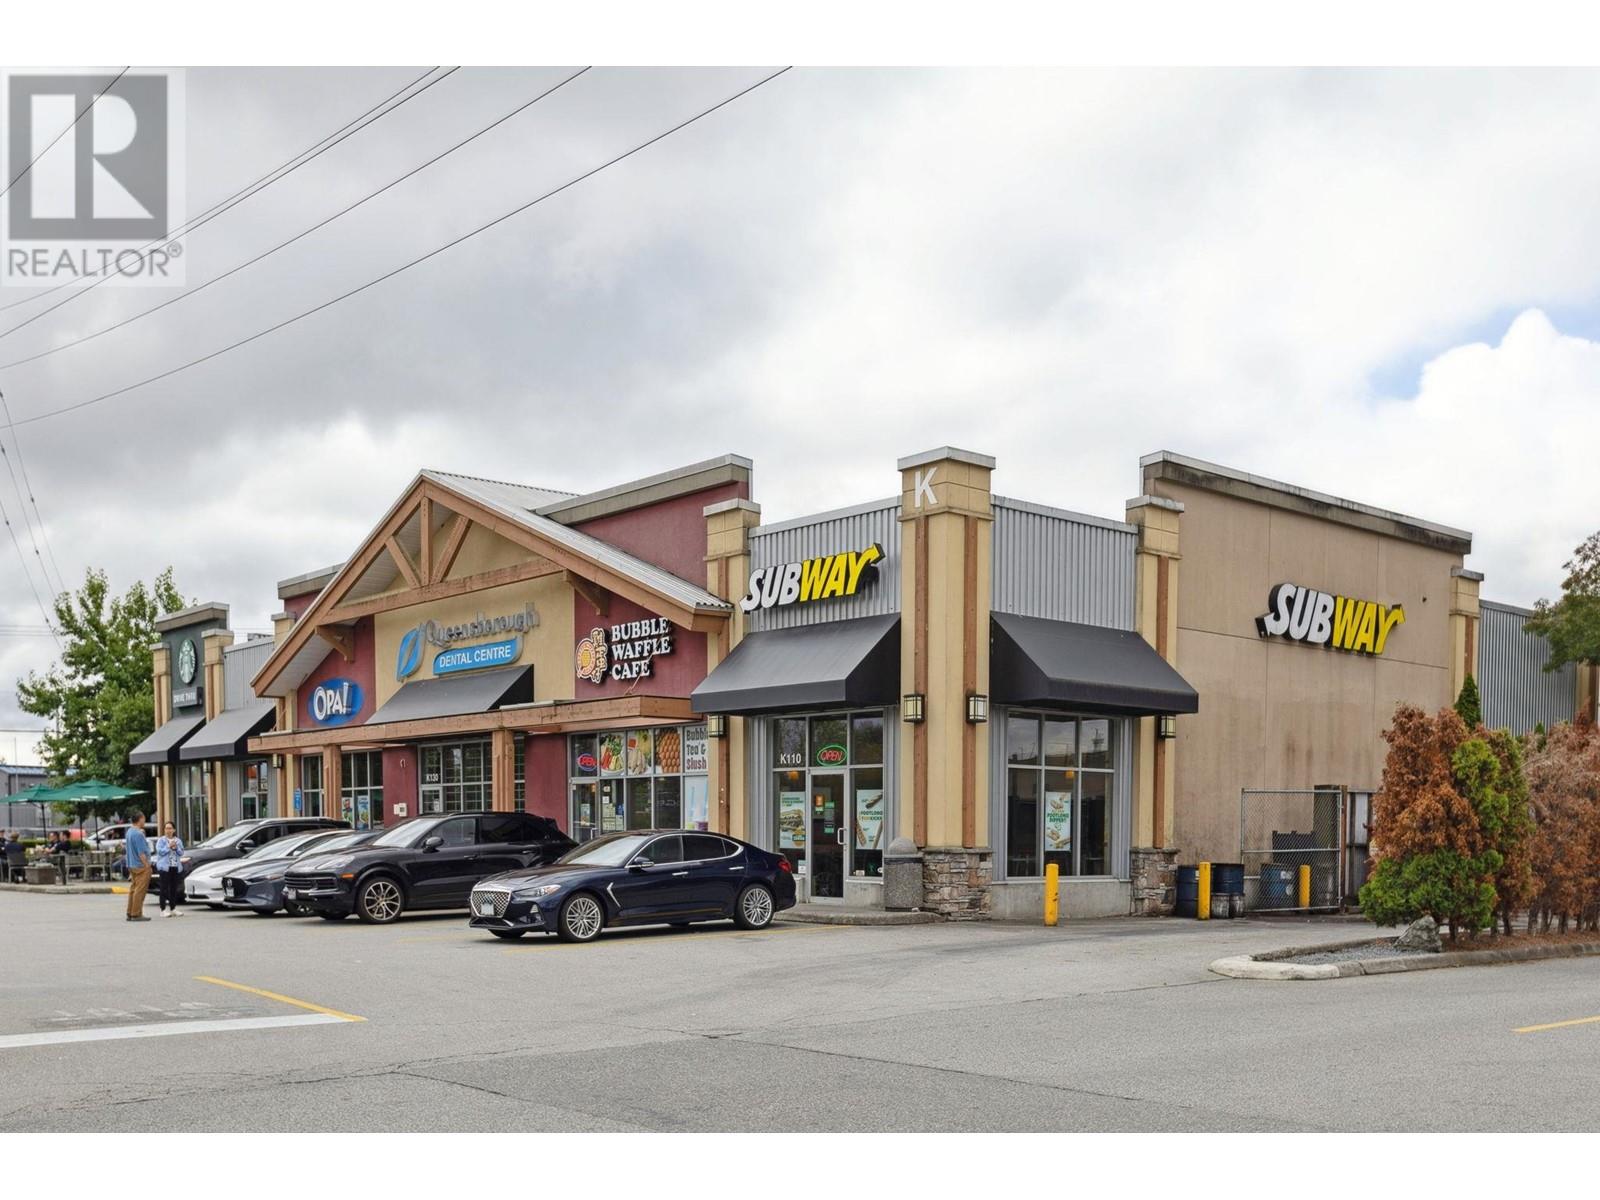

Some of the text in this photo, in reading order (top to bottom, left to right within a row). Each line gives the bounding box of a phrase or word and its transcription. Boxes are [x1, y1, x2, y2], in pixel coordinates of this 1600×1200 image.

[914, 466, 938, 508] K
[739, 543, 884, 613] SUBWAY
[425, 602, 539, 648] Queensborough
[611, 617, 670, 642] BUBBLE
[1260, 583, 1405, 655] SUBWAY
[439, 645, 512, 668] DENTAL CENTRE
[611, 636, 671, 661] WAFFLE
[611, 659, 650, 681] CAFE
[313, 682, 350, 721] OPA!
[686, 744, 699, 756] Tea
[780, 753, 802, 764] K110
[820, 750, 843, 762] OPEN
[686, 756, 707, 770] Slush
